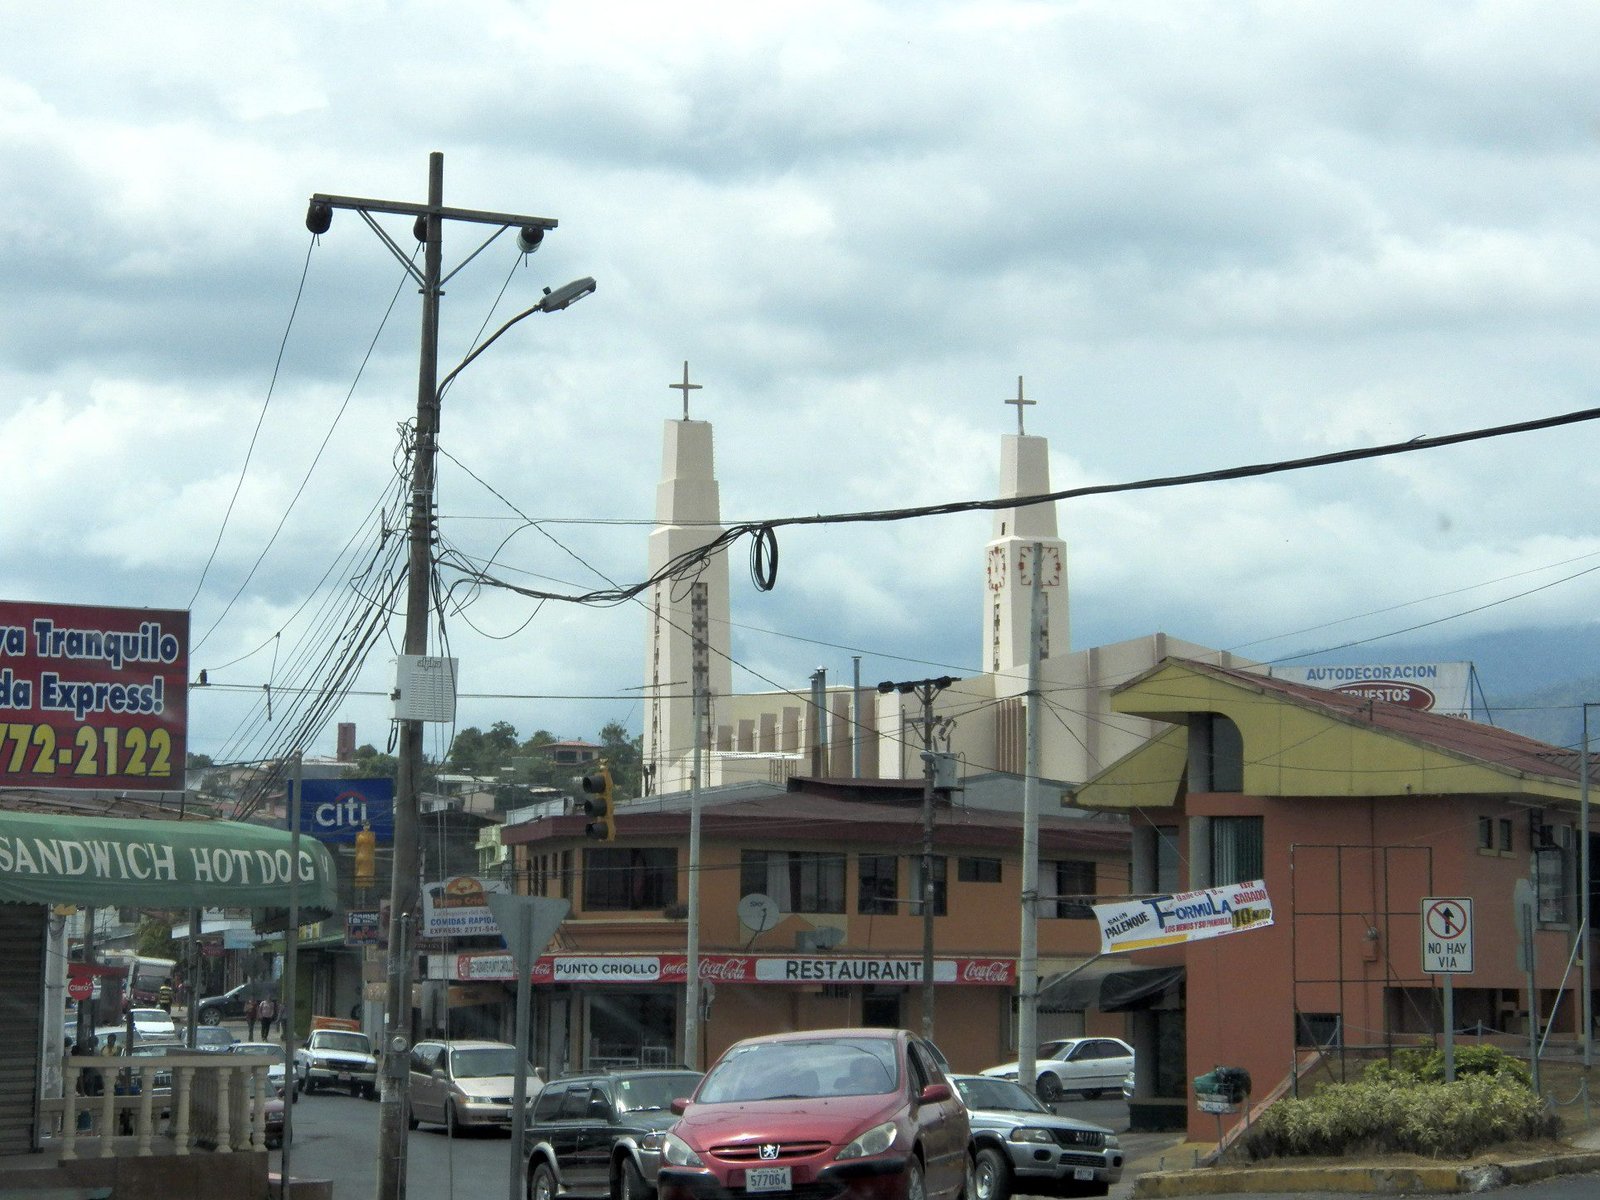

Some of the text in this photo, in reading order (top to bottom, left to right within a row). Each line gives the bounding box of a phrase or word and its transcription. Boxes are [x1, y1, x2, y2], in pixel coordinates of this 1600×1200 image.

[33, 618, 178, 670] Tranquilo
[1307, 665, 1437, 681] AUTODECORACION
[41, 672, 164, 721] Express!
[316, 796, 367, 828] citi
[0, 837, 177, 881] SANDWICH
[190, 847, 253, 884] HOT
[255, 849, 315, 884] DOG
[1104, 911, 1150, 939] PALENQUE
[1428, 942, 1467, 954] NO HAY
[556, 963, 658, 975] PUNTO CRIOLLO
[786, 960, 922, 981] RESTAURANT
[1438, 956, 1457, 968] VIA
[751, 1173, 787, 1187] 577064
